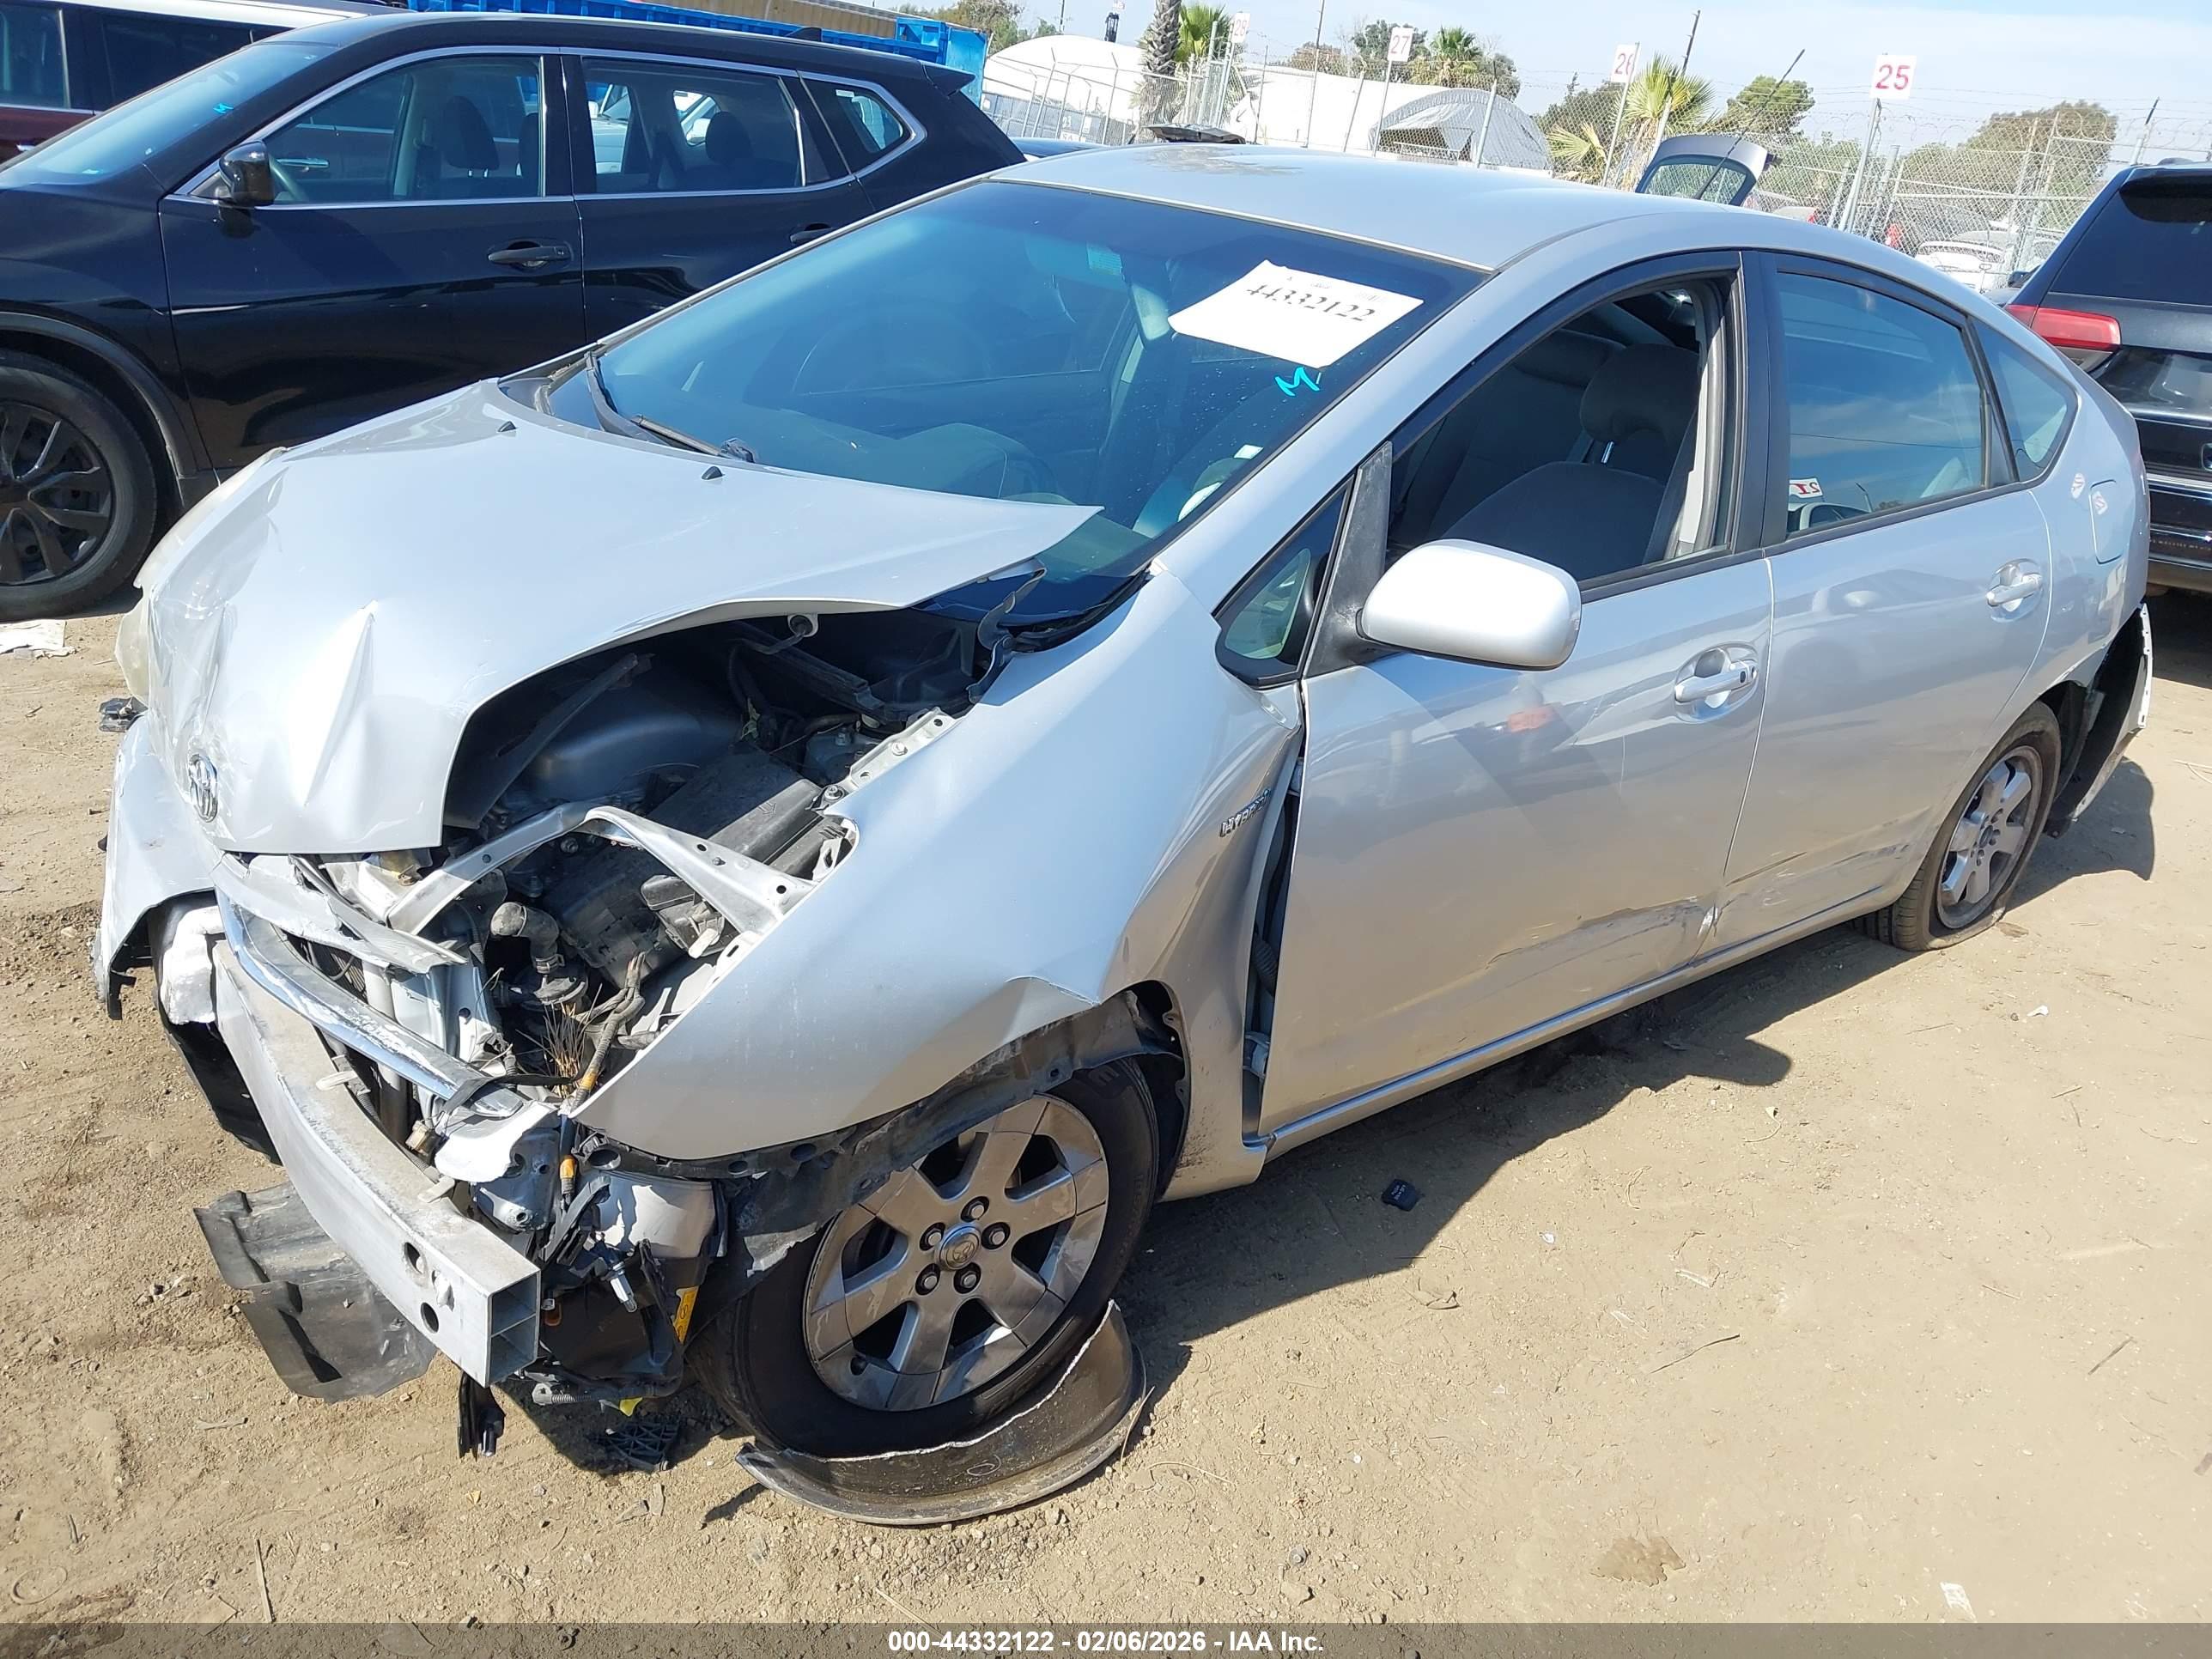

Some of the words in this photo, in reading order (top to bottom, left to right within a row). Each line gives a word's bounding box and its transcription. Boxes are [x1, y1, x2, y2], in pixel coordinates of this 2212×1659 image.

[1234, 19, 1248, 36] 28
[1390, 34, 1410, 54] 27
[1875, 64, 1911, 90] 25
[1246, 284, 1376, 322] 44332122
[1274, 367, 1321, 397] M
